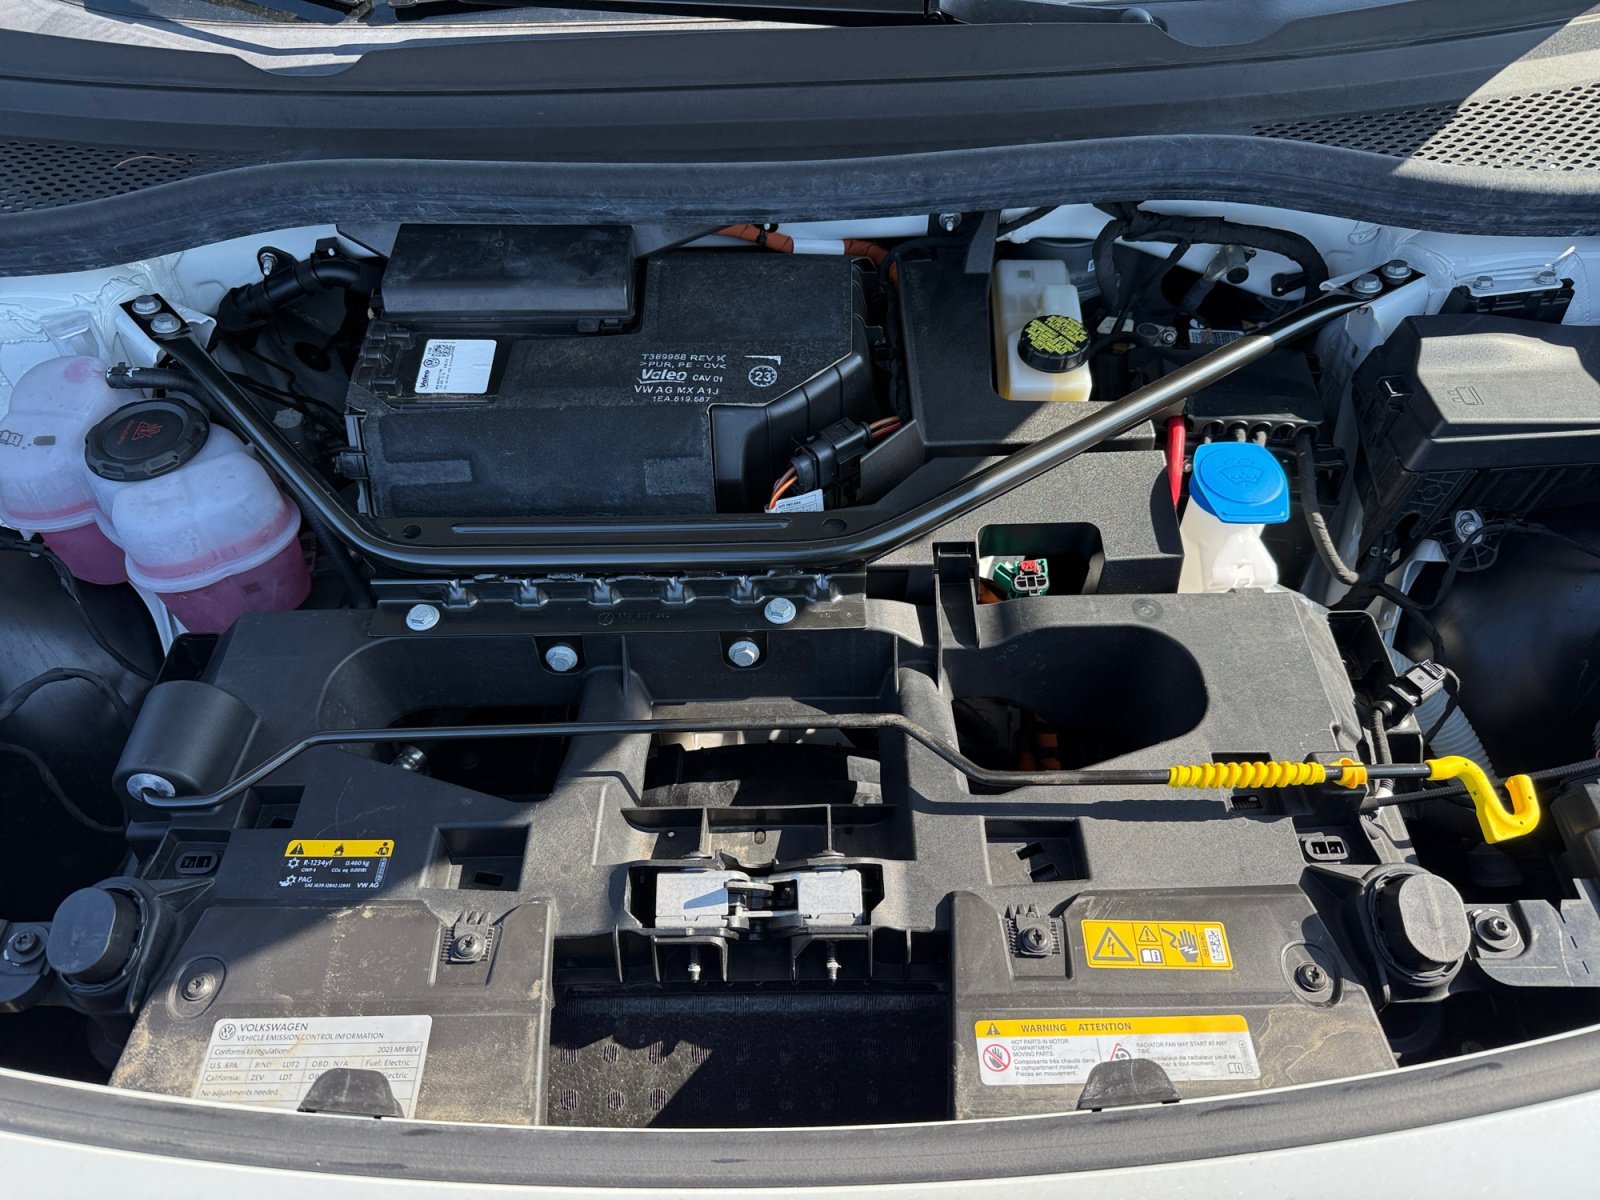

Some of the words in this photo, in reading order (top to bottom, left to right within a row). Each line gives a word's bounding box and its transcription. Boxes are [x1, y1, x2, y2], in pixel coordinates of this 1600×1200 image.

[690, 354, 714, 362] REV
[717, 354, 726, 362] K
[642, 369, 687, 380] Valeo
[692, 374, 711, 382] CAV
[755, 371, 771, 382] 23
[656, 386, 672, 394] AG
[303, 859, 332, 867] R-1234yf
[240, 1023, 309, 1032] VOLKSWAGEN
[1021, 1024, 1067, 1032] WARNING
[1078, 1023, 1131, 1032] ATTENTION
[237, 1034, 264, 1042] VEHICLE
[335, 1032, 384, 1040] INFORMATION
[282, 1060, 299, 1068] LDT2
[212, 1090, 252, 1098] adjustments
